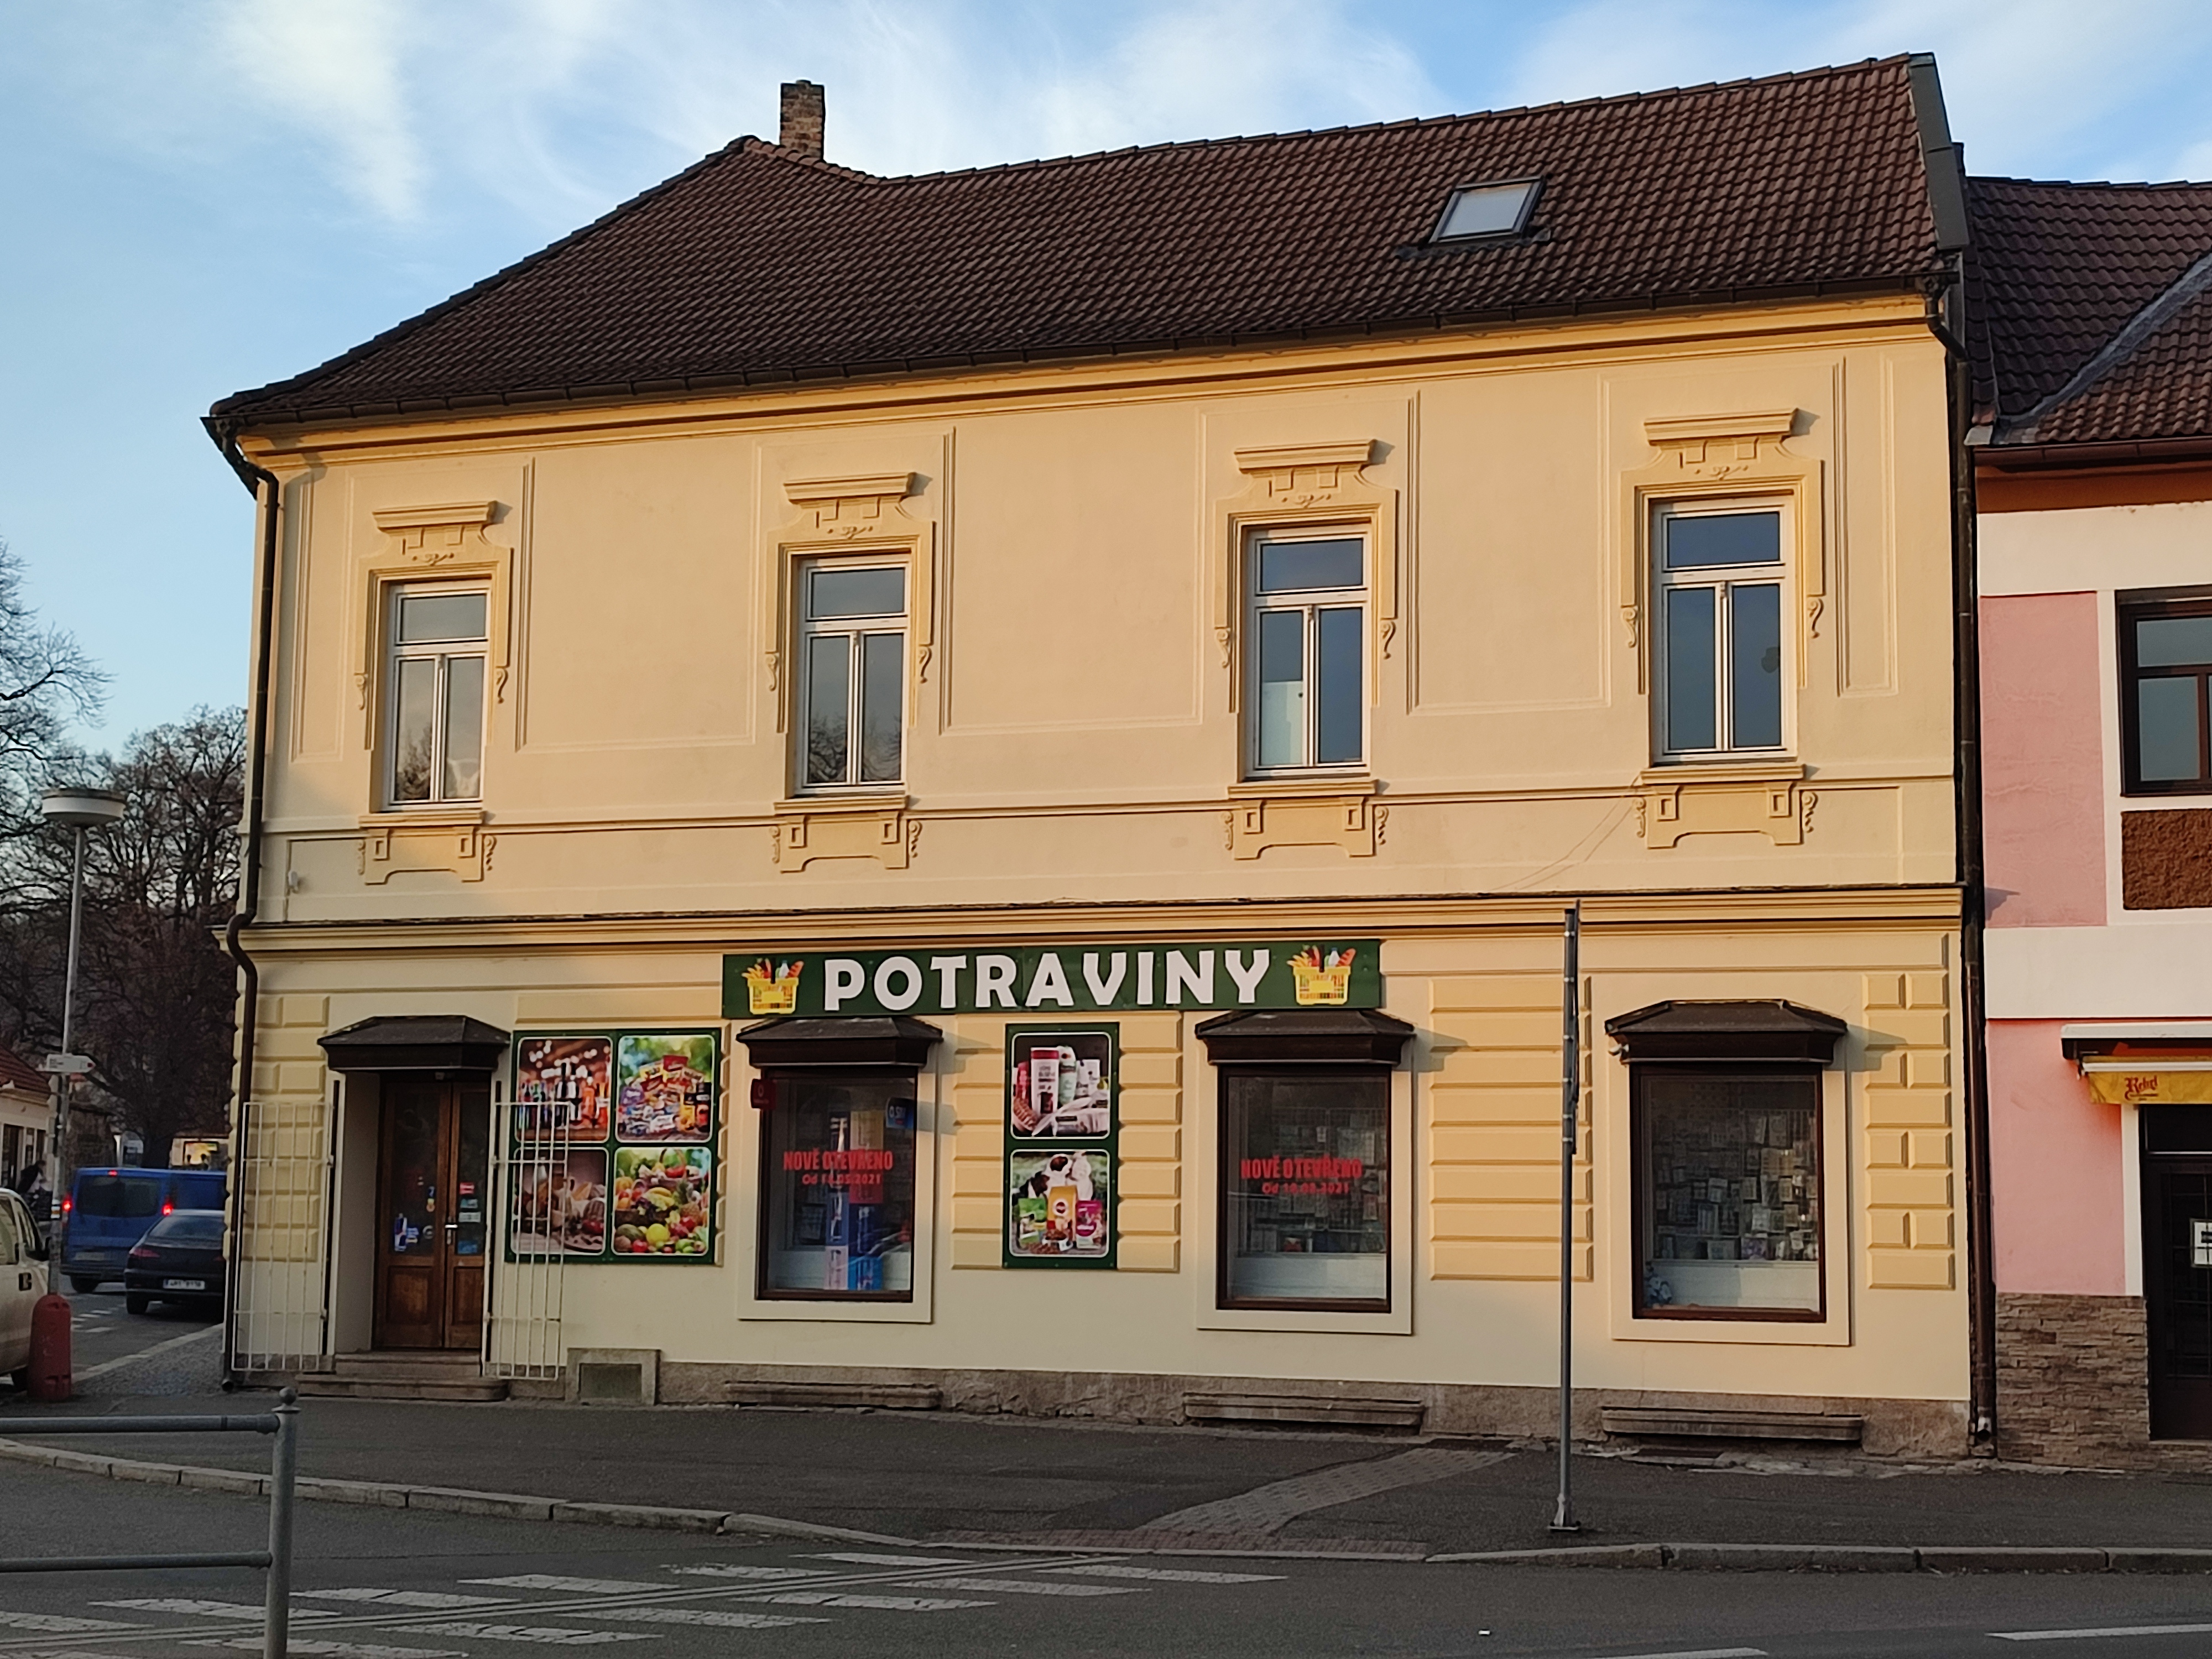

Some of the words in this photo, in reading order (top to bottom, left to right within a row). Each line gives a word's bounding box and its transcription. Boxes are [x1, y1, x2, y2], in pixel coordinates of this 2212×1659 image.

[823, 949, 1270, 1011] POTRAVINY
[822, 1147, 893, 1171] OTEVŘENO
[1282, 1154, 1363, 1179] OTEVŘENO
